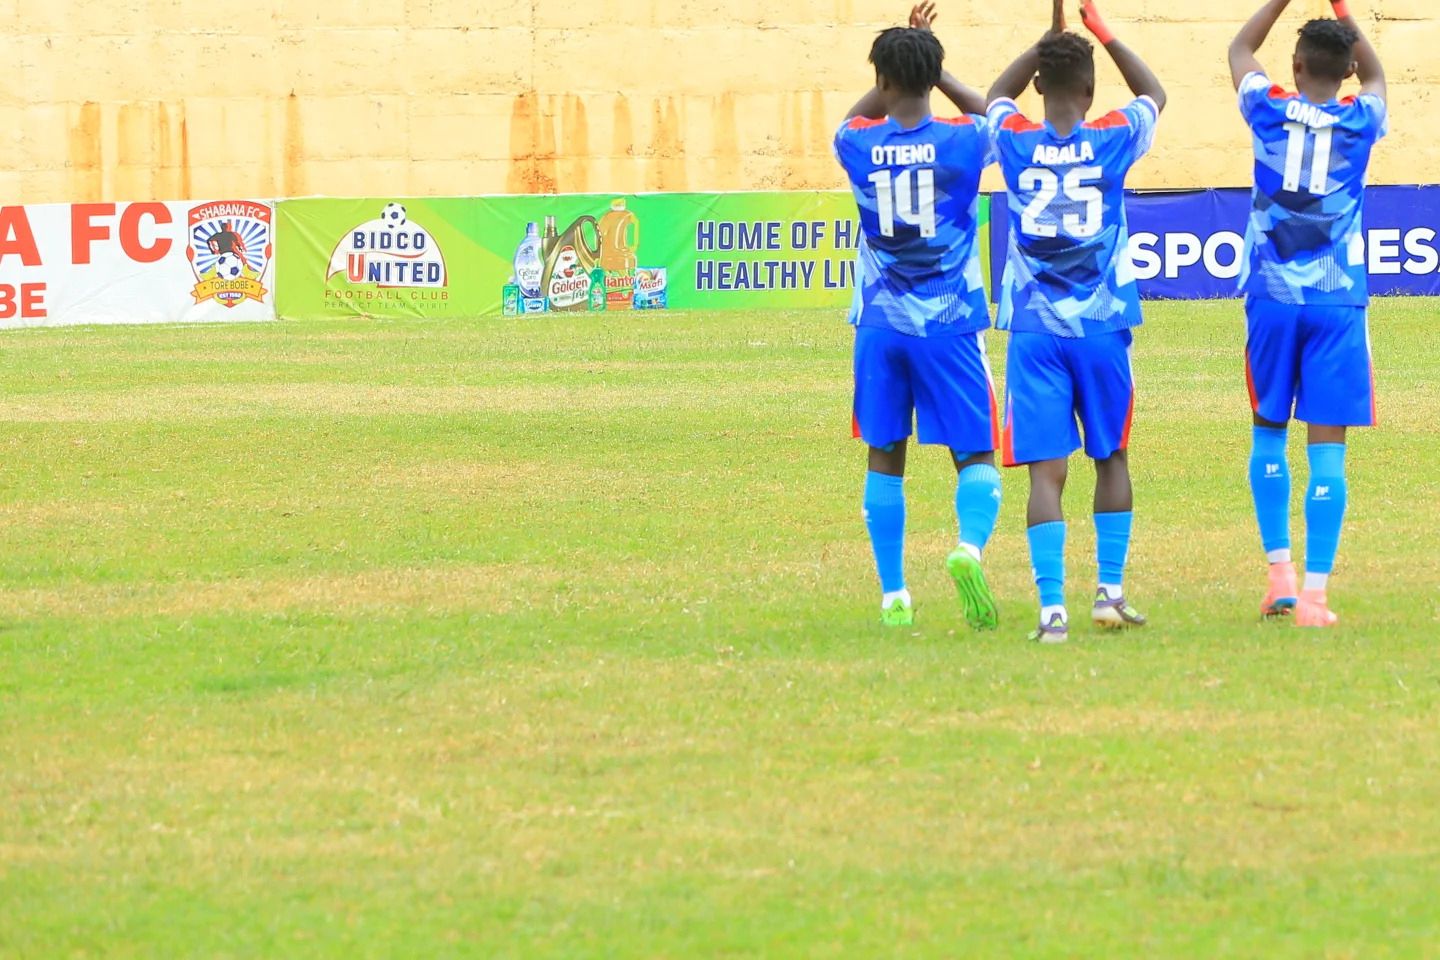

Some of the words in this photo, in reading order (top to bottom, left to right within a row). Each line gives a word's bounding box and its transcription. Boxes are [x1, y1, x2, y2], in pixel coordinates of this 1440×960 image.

[871, 143, 936, 165] OTIENO
[1032, 141, 1095, 165] ABALA
[1282, 122, 1333, 195] 11
[199, 204, 245, 220] SHABANA
[246, 206, 260, 219] FC
[867, 168, 936, 238] 14
[1017, 165, 1103, 238] 25
[71, 201, 173, 265] FC
[353, 231, 426, 250] BIDCO
[697, 221, 782, 251] HOME
[791, 221, 826, 250] OF
[347, 253, 441, 283] UNITED
[697, 260, 816, 290] HEALTHY
[210, 280, 229, 290] TORE
[230, 280, 249, 289] BOBE
[325, 290, 402, 300] FOOTBALL
[411, 291, 449, 300] CLUB
[552, 279, 589, 295] Golden
[640, 278, 663, 290] Msafi
[324, 301, 372, 309] PERFECT
